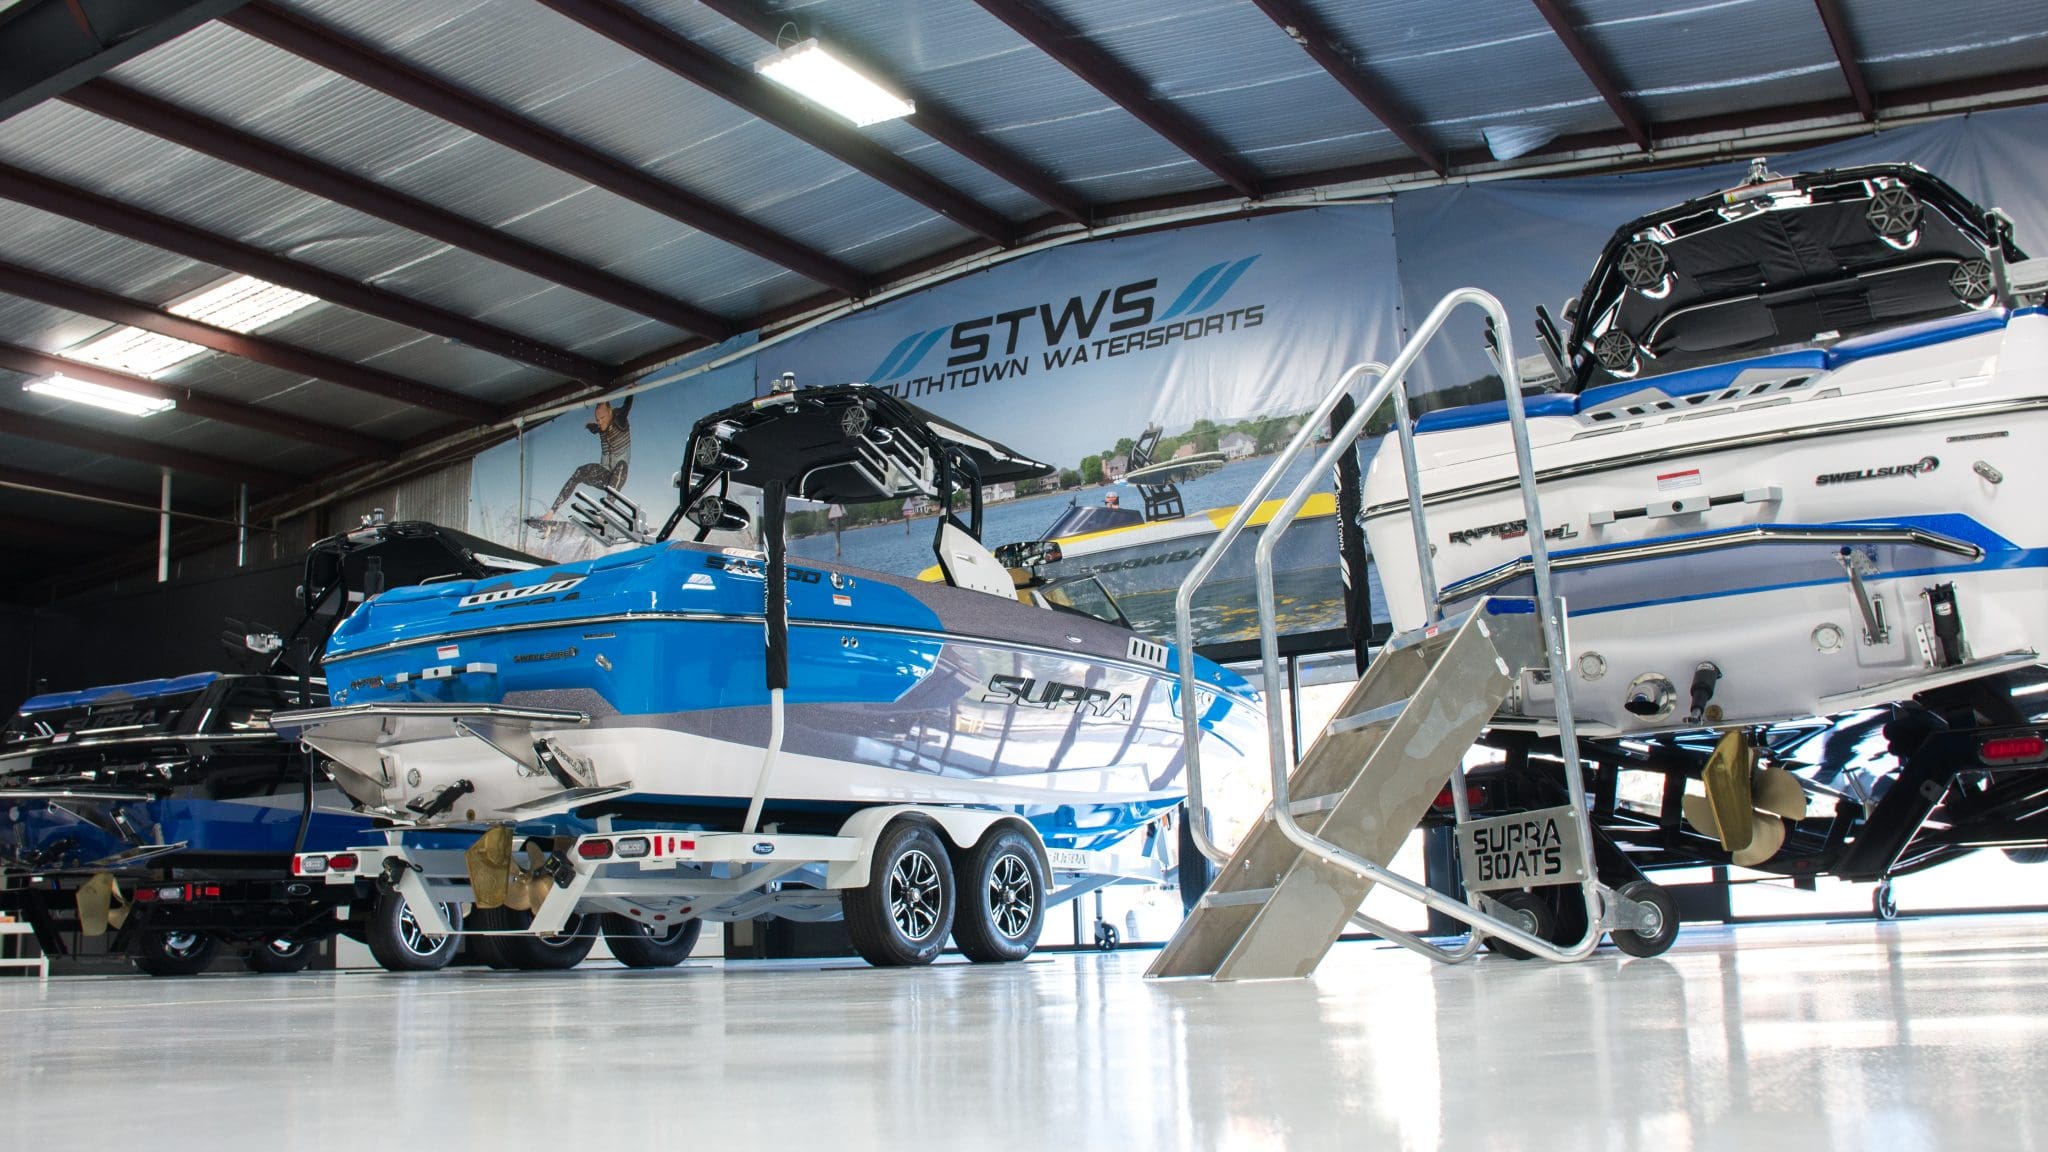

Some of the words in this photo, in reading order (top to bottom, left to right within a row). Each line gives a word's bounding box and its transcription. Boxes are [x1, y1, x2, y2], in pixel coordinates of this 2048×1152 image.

[947, 278, 1159, 367] STWS
[880, 355, 1028, 400] UTHTOWN
[1043, 304, 1265, 372] WATERSPORTS
[1816, 461, 1926, 486] SWELLSURF
[981, 673, 1132, 721] SUPRA
[1473, 818, 1562, 855] SUPRA
[1478, 847, 1562, 881] BOATS
